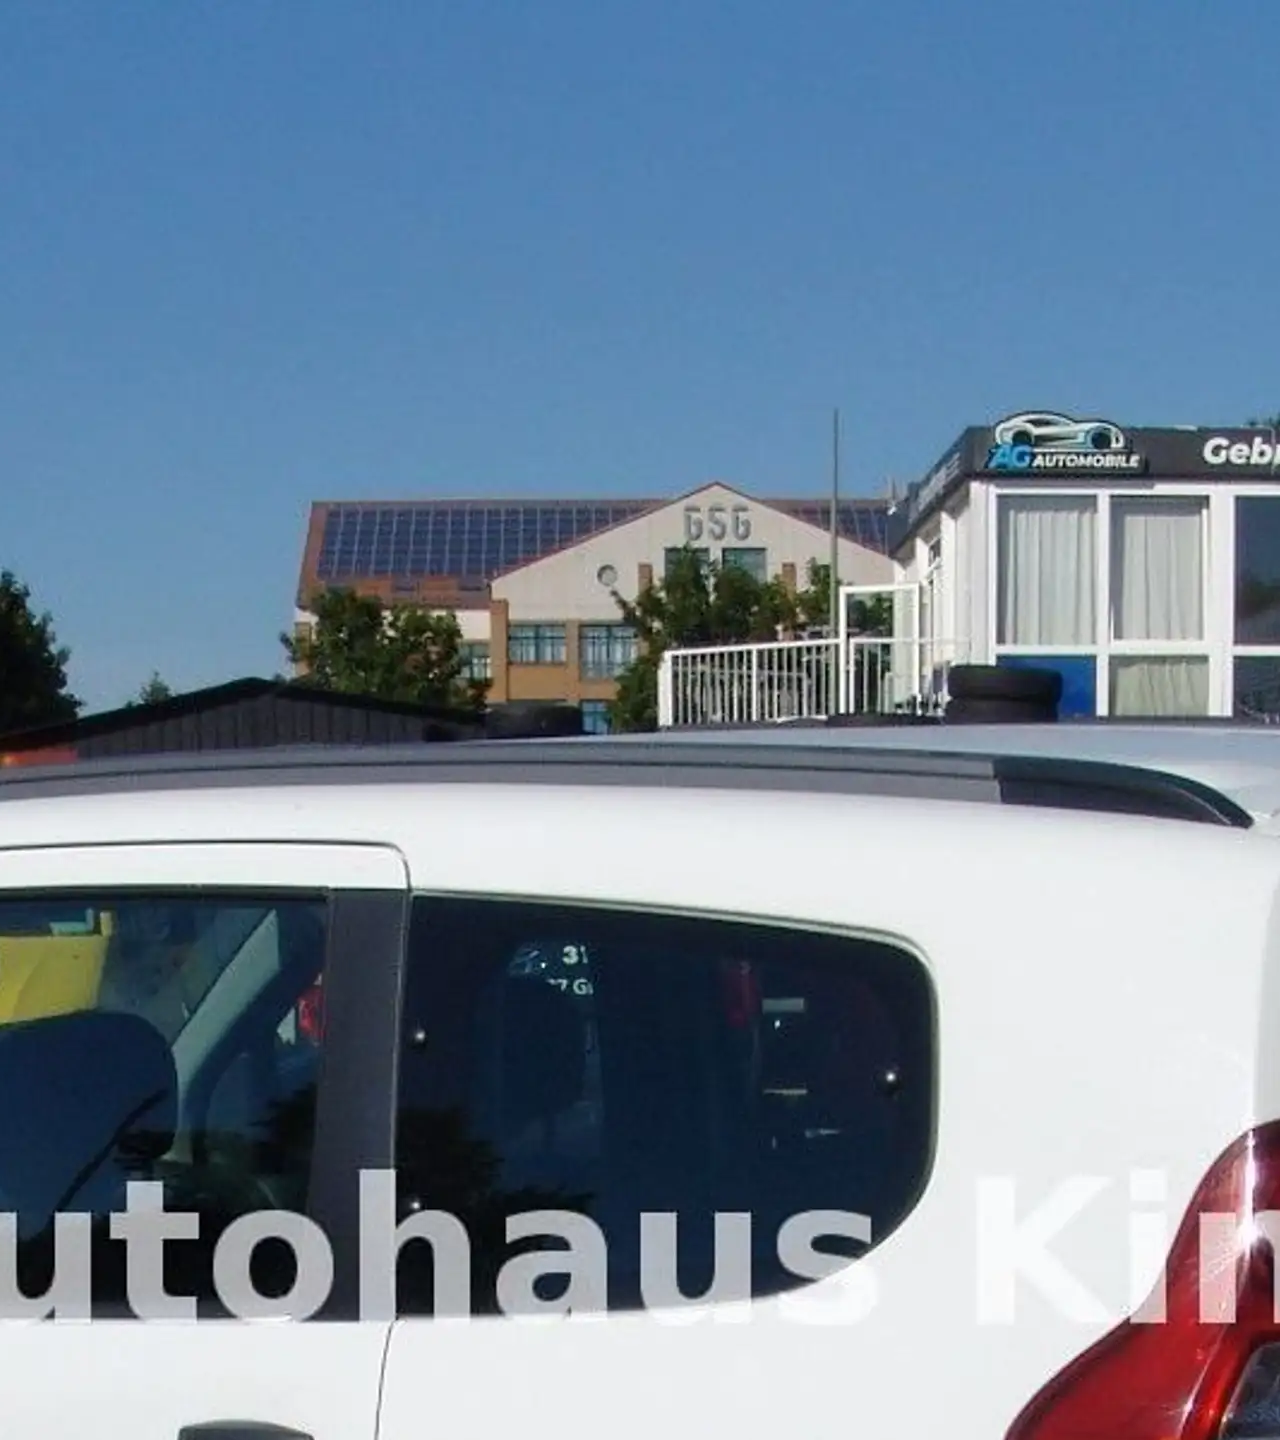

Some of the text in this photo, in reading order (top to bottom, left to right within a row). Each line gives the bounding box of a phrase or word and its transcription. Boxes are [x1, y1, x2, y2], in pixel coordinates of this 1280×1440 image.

[987, 444, 1141, 468] AG AUTOMOBILE
[683, 503, 752, 541] GSG
